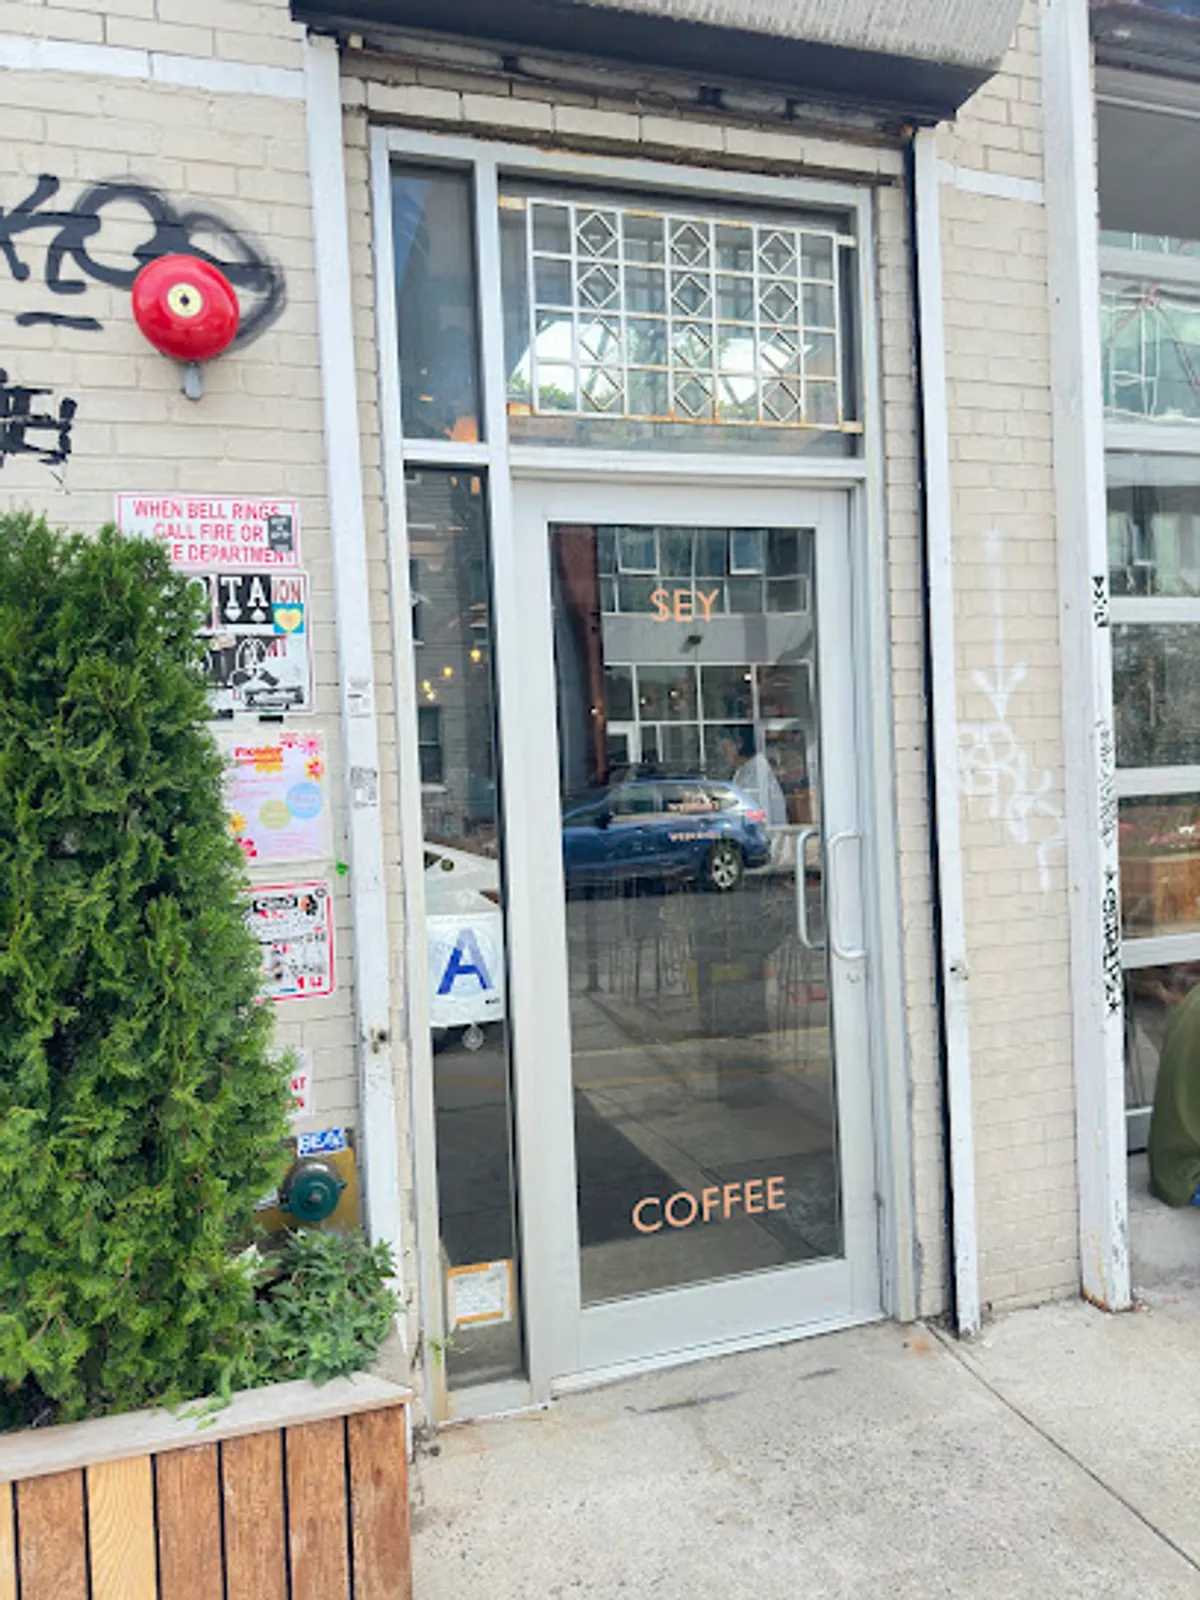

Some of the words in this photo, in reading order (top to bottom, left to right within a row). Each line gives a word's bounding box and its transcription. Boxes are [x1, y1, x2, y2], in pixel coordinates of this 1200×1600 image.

[133, 500, 183, 518] WHEN
[188, 503, 227, 519] BELL
[232, 504, 281, 521] RINGS
[153, 521, 197, 540] CALL
[201, 523, 236, 541] FIRE
[240, 525, 263, 542] OR
[188, 544, 293, 563] DEPARTMENT
[650, 588, 719, 623] SEY
[436, 928, 495, 995] A
[632, 1176, 786, 1233] COFFEE
